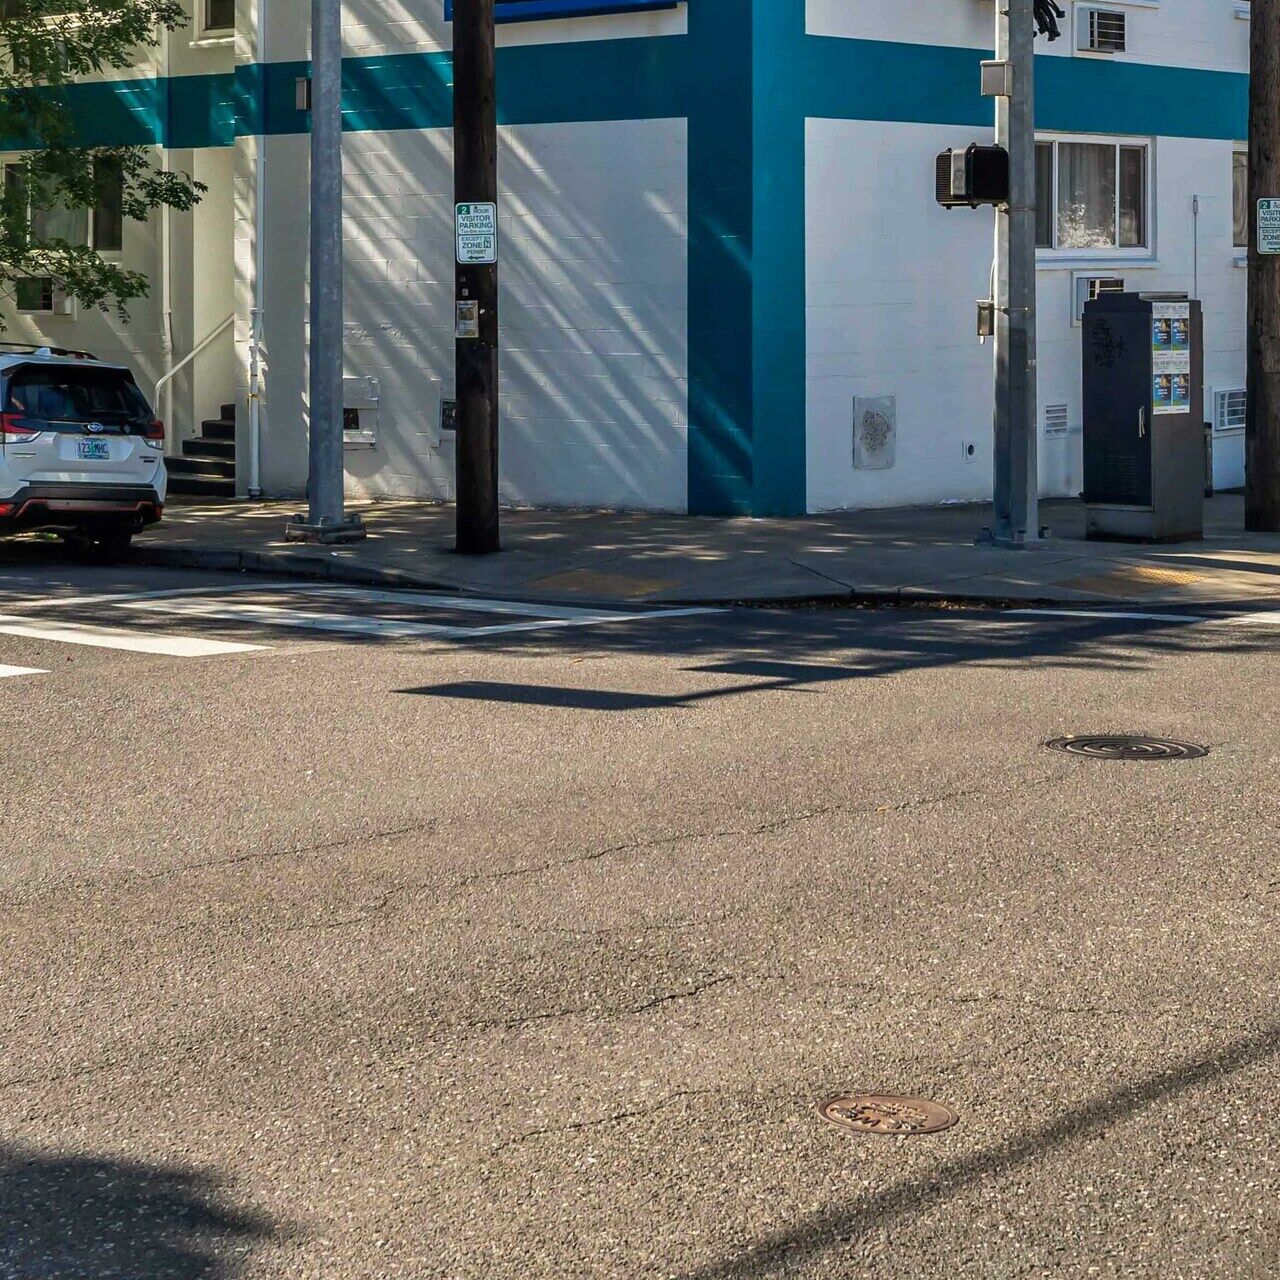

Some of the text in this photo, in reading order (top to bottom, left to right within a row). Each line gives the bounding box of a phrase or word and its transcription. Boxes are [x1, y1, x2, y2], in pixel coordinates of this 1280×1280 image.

[1262, 201, 1268, 209] 2
[461, 206, 467, 214] 2
[460, 214, 491, 222] VISITOR
[77, 442, 91, 453] 123
